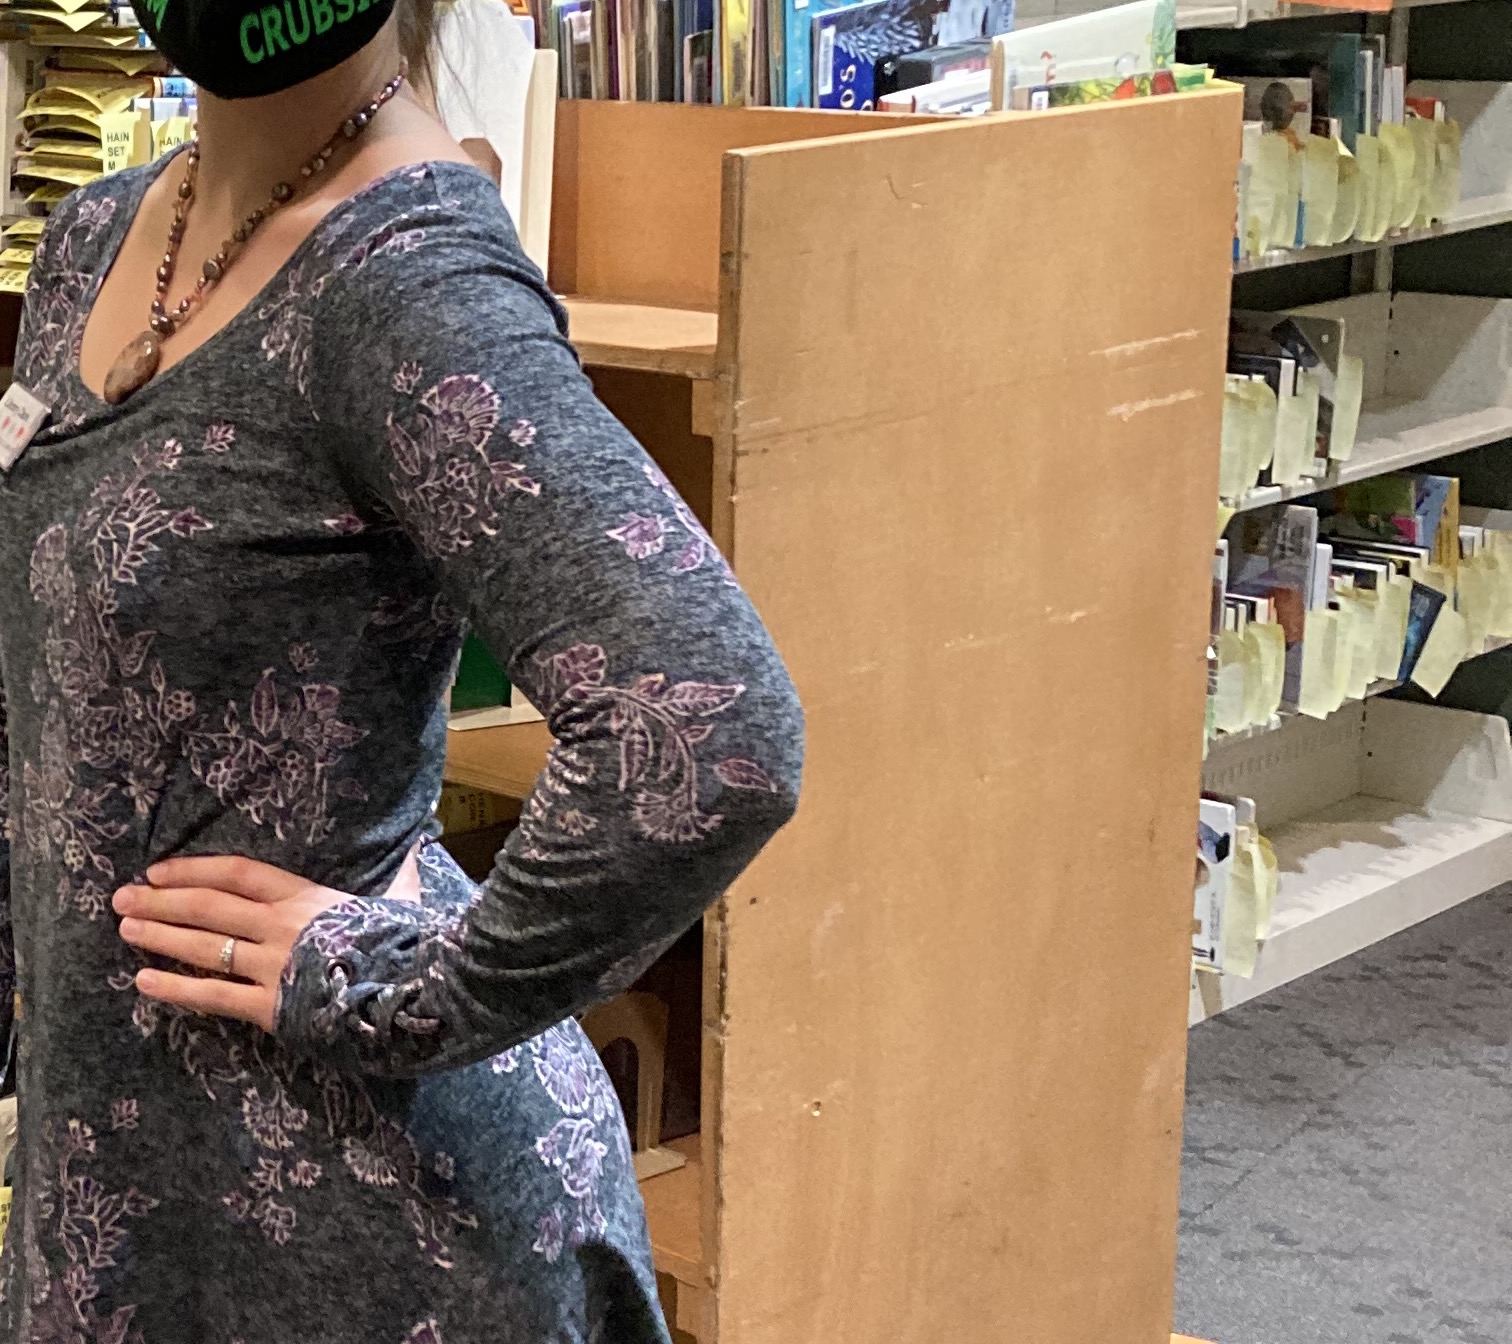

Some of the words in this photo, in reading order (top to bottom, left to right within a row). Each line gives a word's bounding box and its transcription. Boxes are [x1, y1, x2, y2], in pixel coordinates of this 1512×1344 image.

[107, 132, 129, 142] HAIN
[108, 147, 125, 157] SET
[108, 161, 115, 170] M
